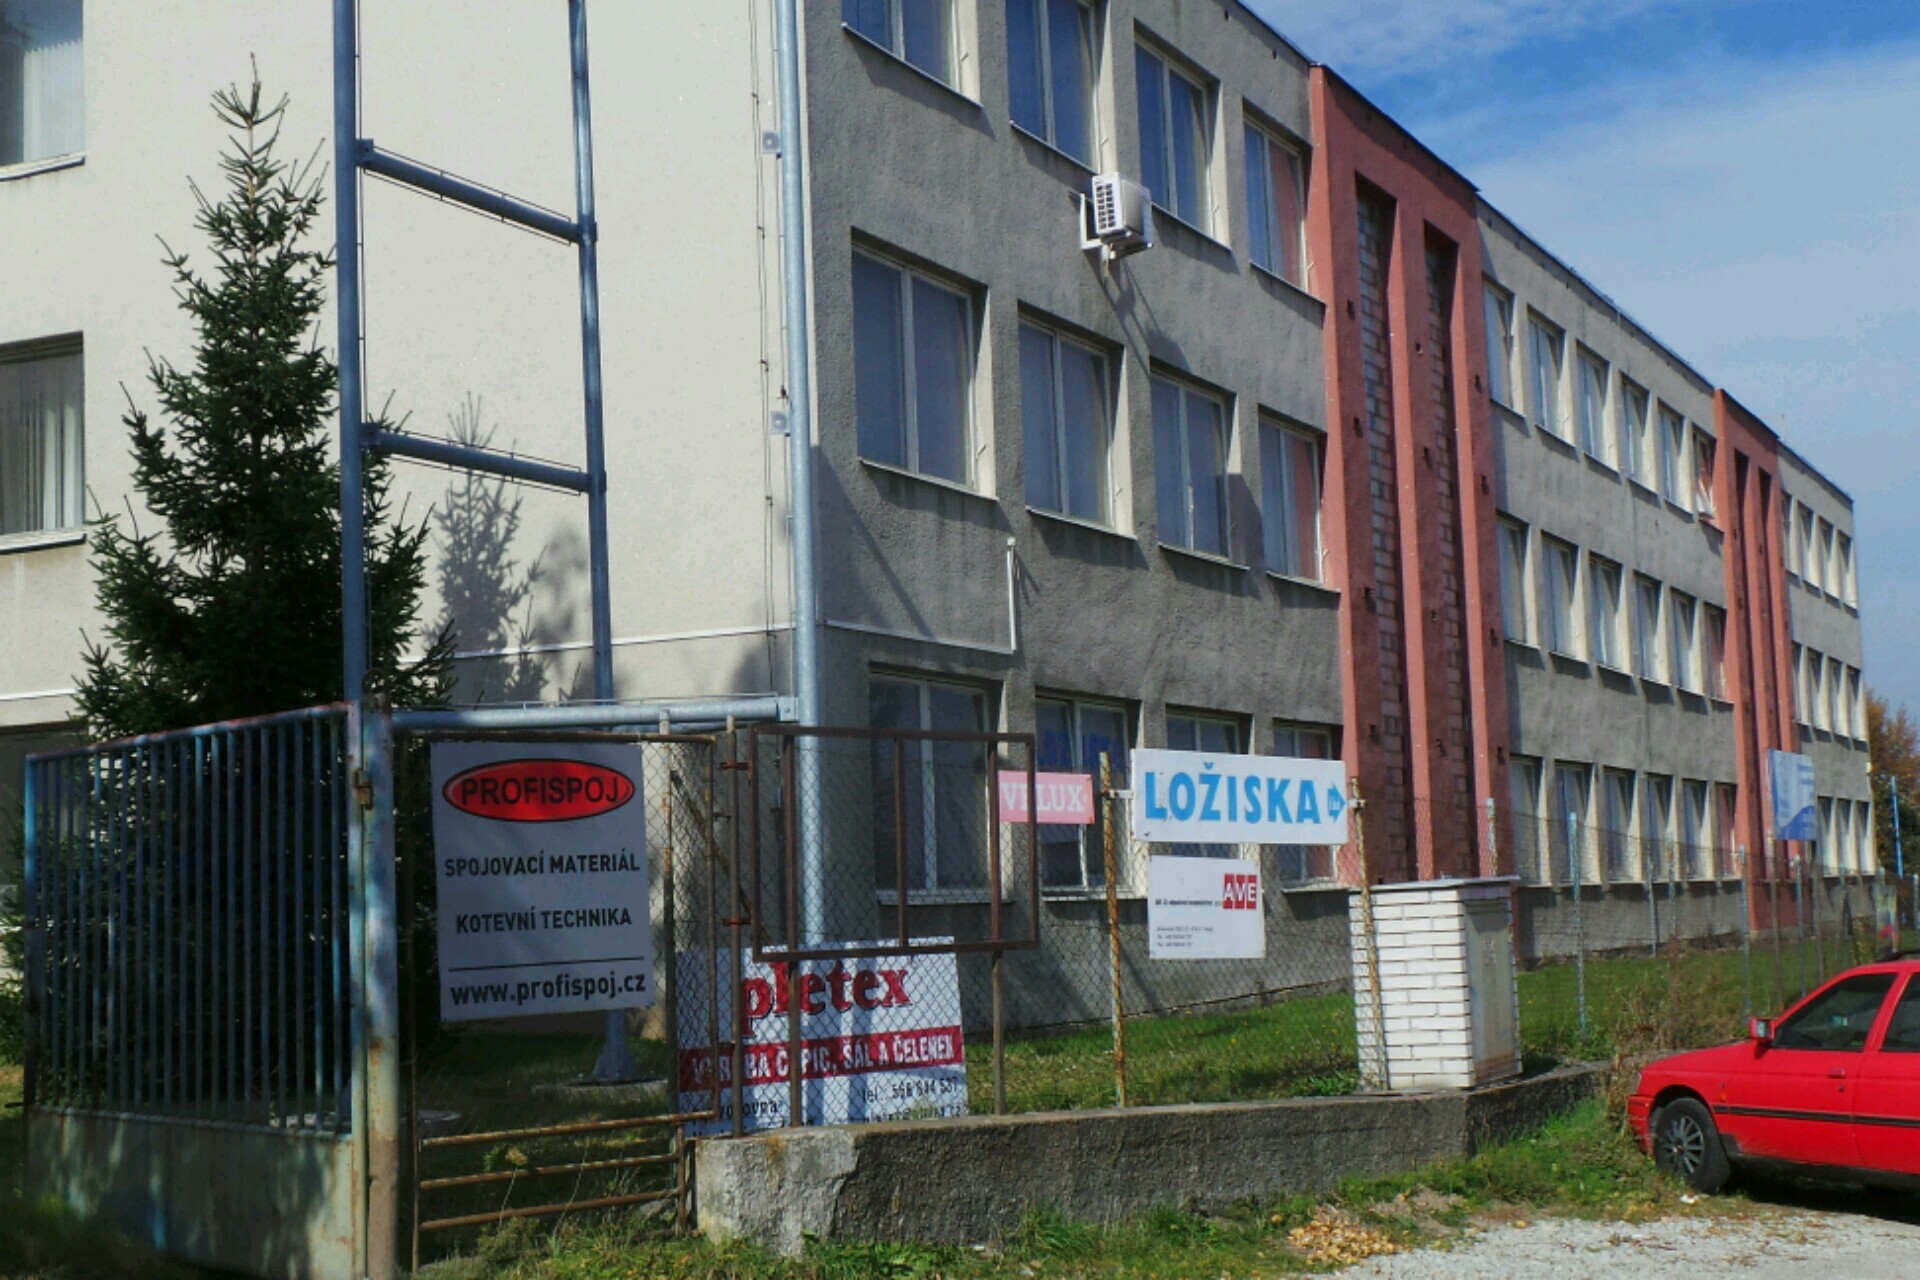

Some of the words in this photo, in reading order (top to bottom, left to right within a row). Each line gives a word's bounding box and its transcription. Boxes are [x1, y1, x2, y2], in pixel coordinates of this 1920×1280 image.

[460, 777, 620, 805] PROFISPOJ
[1144, 761, 1321, 825] LOŽISKA
[445, 850, 544, 877] SPOJOVACÍ
[550, 848, 640, 873] MATERIÁL
[457, 906, 536, 933] KOTEVNÍ
[541, 908, 632, 929] TECHNIKA
[452, 971, 646, 1005] www.profispoj.cz
[740, 960, 913, 1038] pletex
[776, 1045, 839, 1075] ČPIC,
[878, 1041, 889, 1066] A
